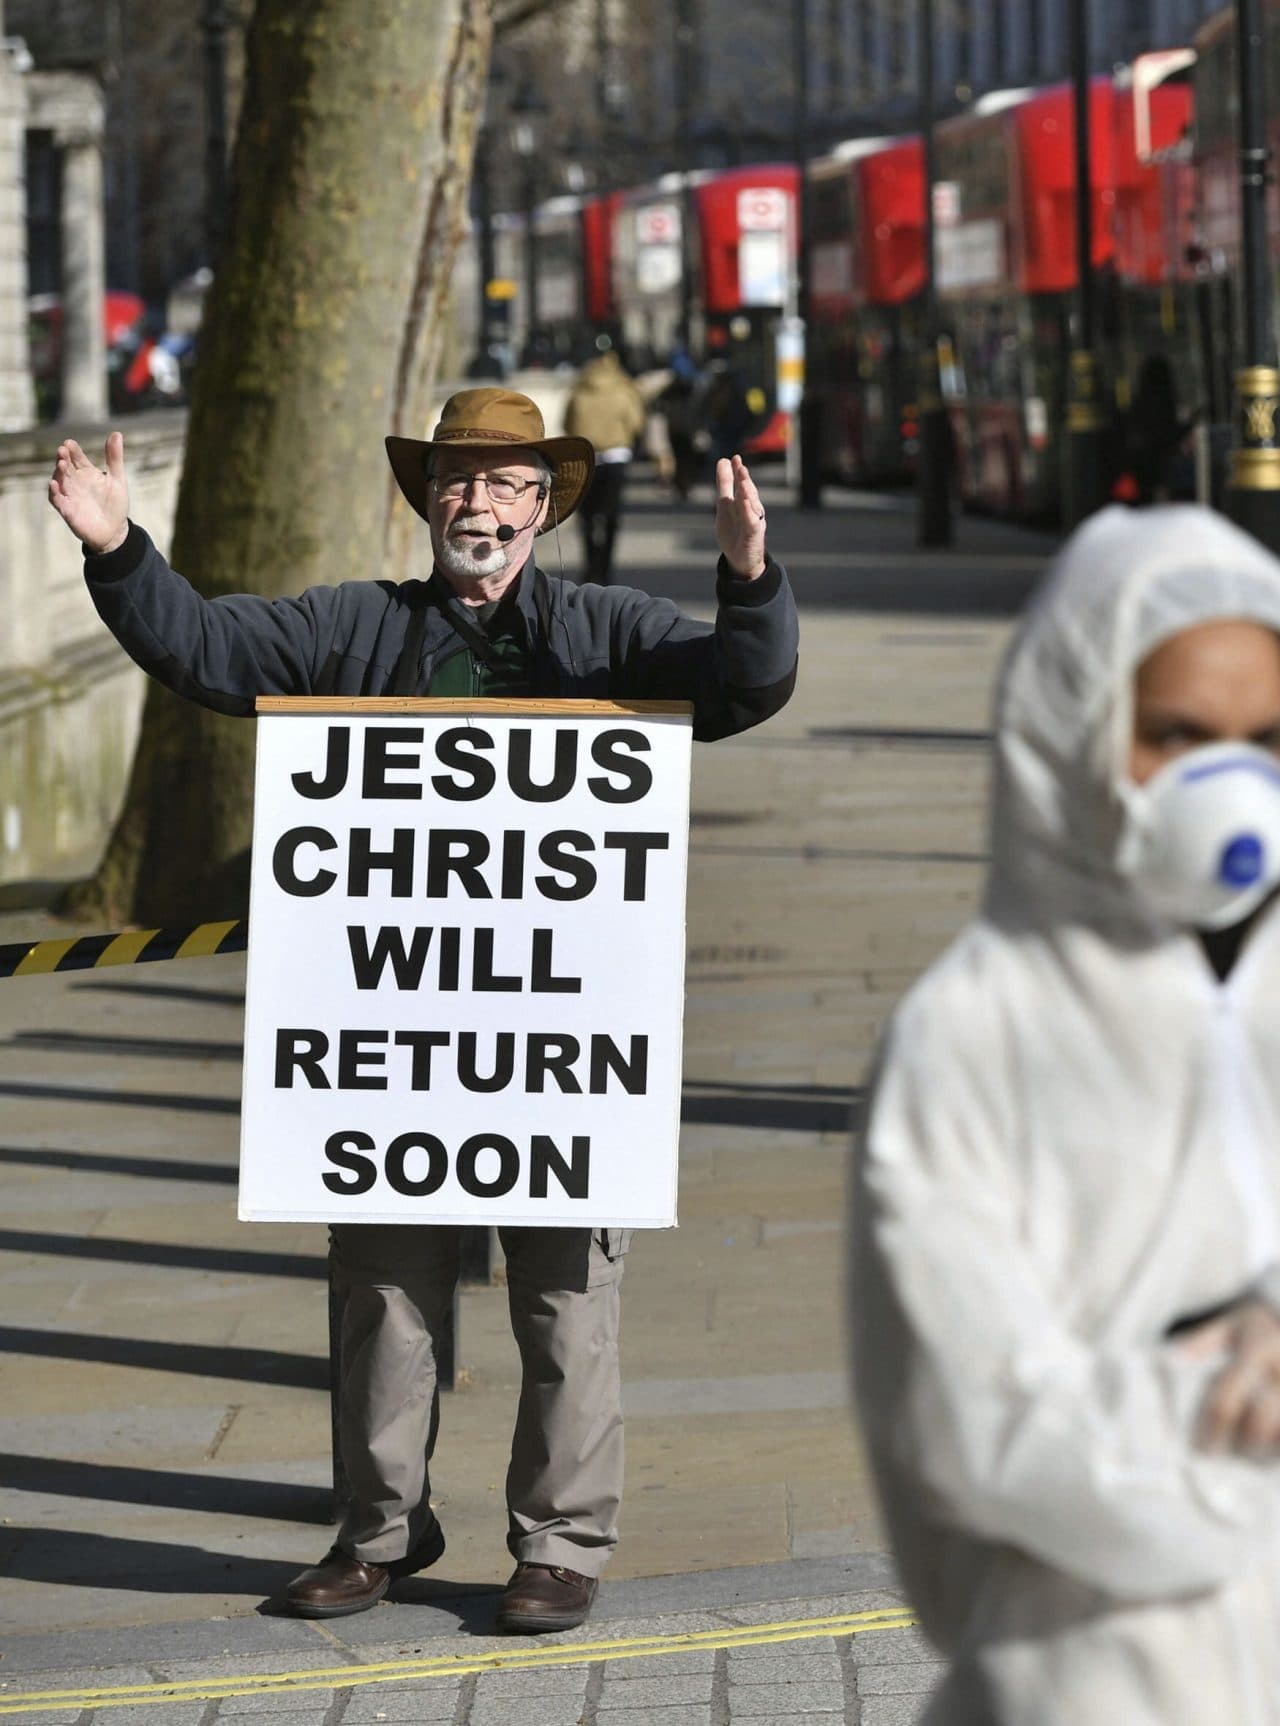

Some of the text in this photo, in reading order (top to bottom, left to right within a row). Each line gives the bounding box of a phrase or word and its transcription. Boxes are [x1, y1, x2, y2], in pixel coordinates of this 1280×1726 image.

[291, 726, 653, 803] JESUS
[272, 826, 669, 902] CHRIST
[347, 925, 582, 994] WILL
[274, 1028, 649, 1095] RETURN
[321, 1130, 591, 1199] SOON
